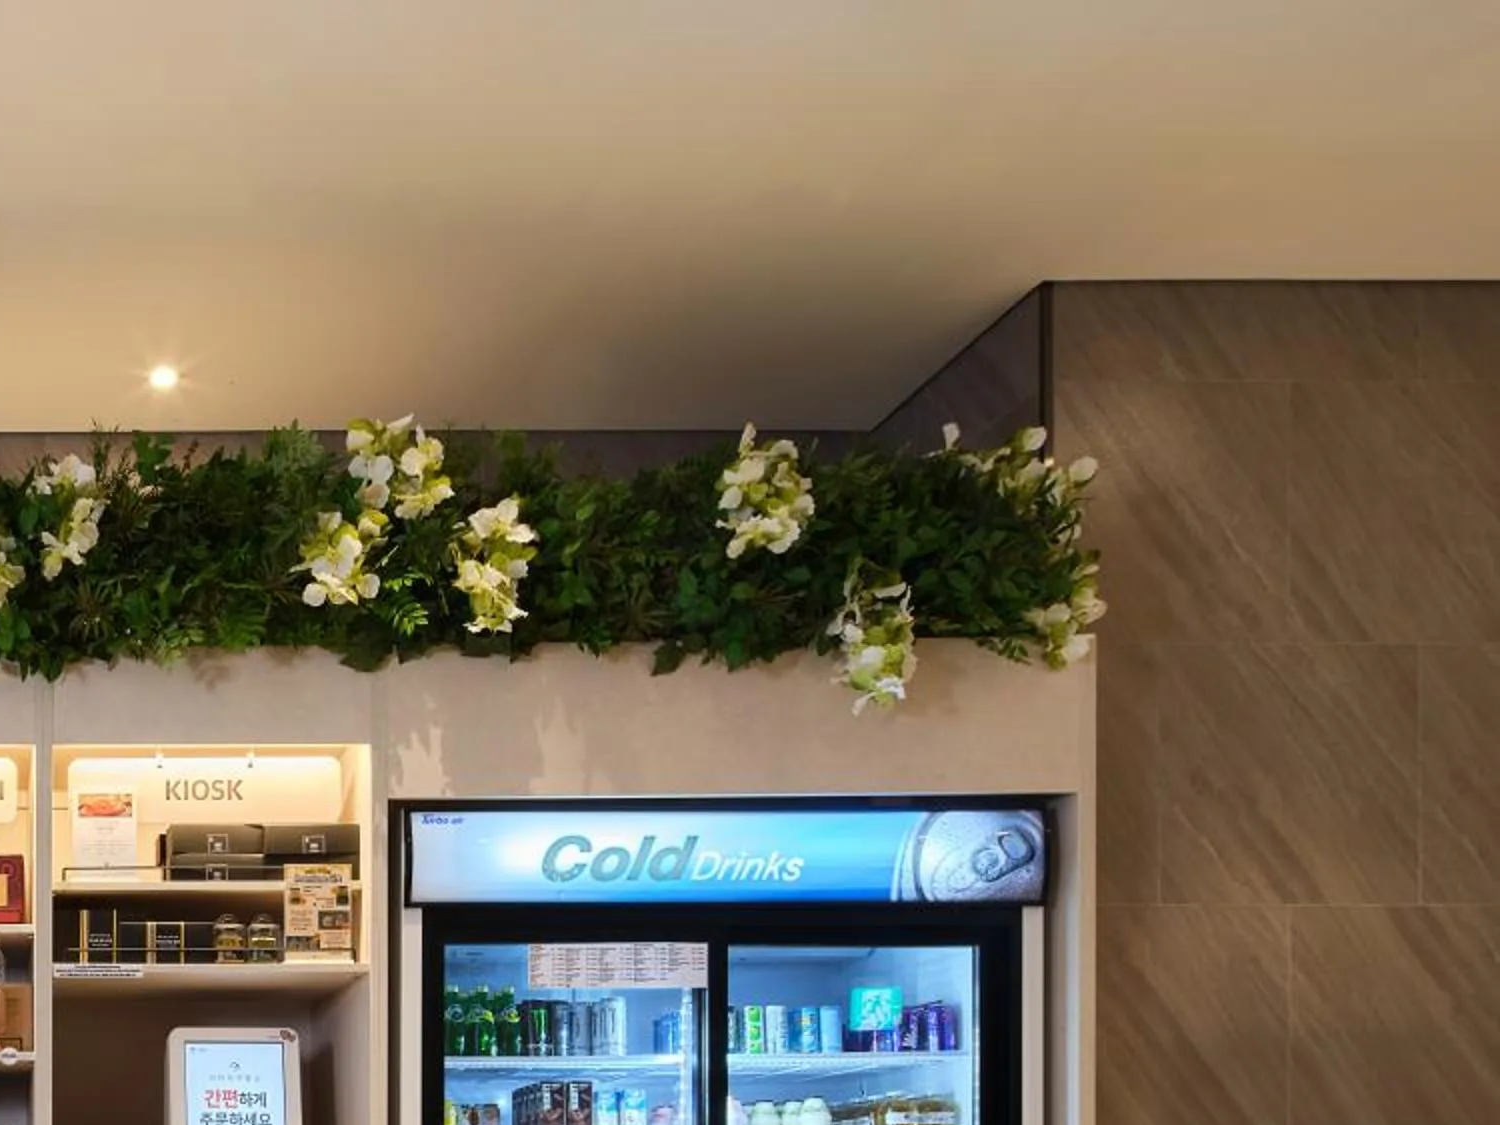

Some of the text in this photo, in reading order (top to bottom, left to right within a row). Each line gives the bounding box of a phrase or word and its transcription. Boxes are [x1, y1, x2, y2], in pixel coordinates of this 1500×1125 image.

[164, 779, 244, 802] KIOSK
[541, 834, 806, 883] Cold Drinks
[203, 1088, 268, 1109] 간편하게
